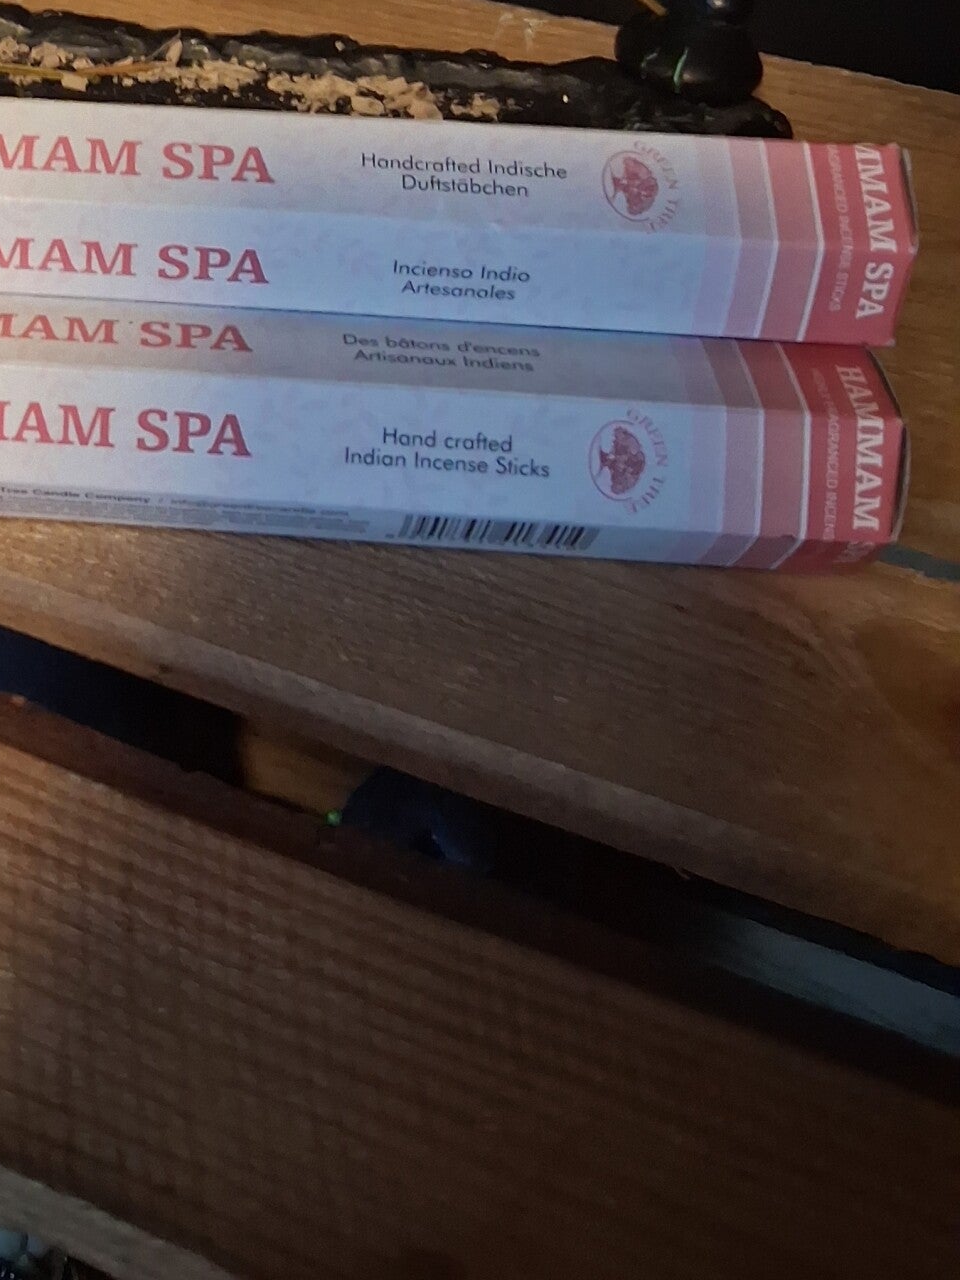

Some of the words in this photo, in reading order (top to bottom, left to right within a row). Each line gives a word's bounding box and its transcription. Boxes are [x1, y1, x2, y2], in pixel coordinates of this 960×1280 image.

[161, 141, 275, 184] SPA
[361, 152, 481, 174] Handcrafted
[488, 160, 568, 179] Indische
[401, 174, 529, 197] Duftstäbchen
[157, 244, 269, 284] SPA
[393, 259, 473, 280] Incienso
[481, 266, 531, 283] Indio
[401, 280, 516, 301] Artesanales
[828, 272, 849, 312] STICKS
[856, 261, 895, 319] SPA
[139, 320, 253, 353] SPA
[342, 333, 379, 347] Des
[384, 336, 450, 352] bâtons
[457, 340, 540, 357] d'encens
[354, 349, 456, 367] Artisanaux
[463, 355, 534, 371] Indiens
[135, 407, 252, 457] SPA
[383, 427, 437, 448] Hand
[443, 432, 513, 453] crafted
[835, 364, 885, 531] HAMMAM
[344, 447, 406, 468] Indian
[414, 452, 488, 473] Incense
[495, 457, 550, 478] Sticks
